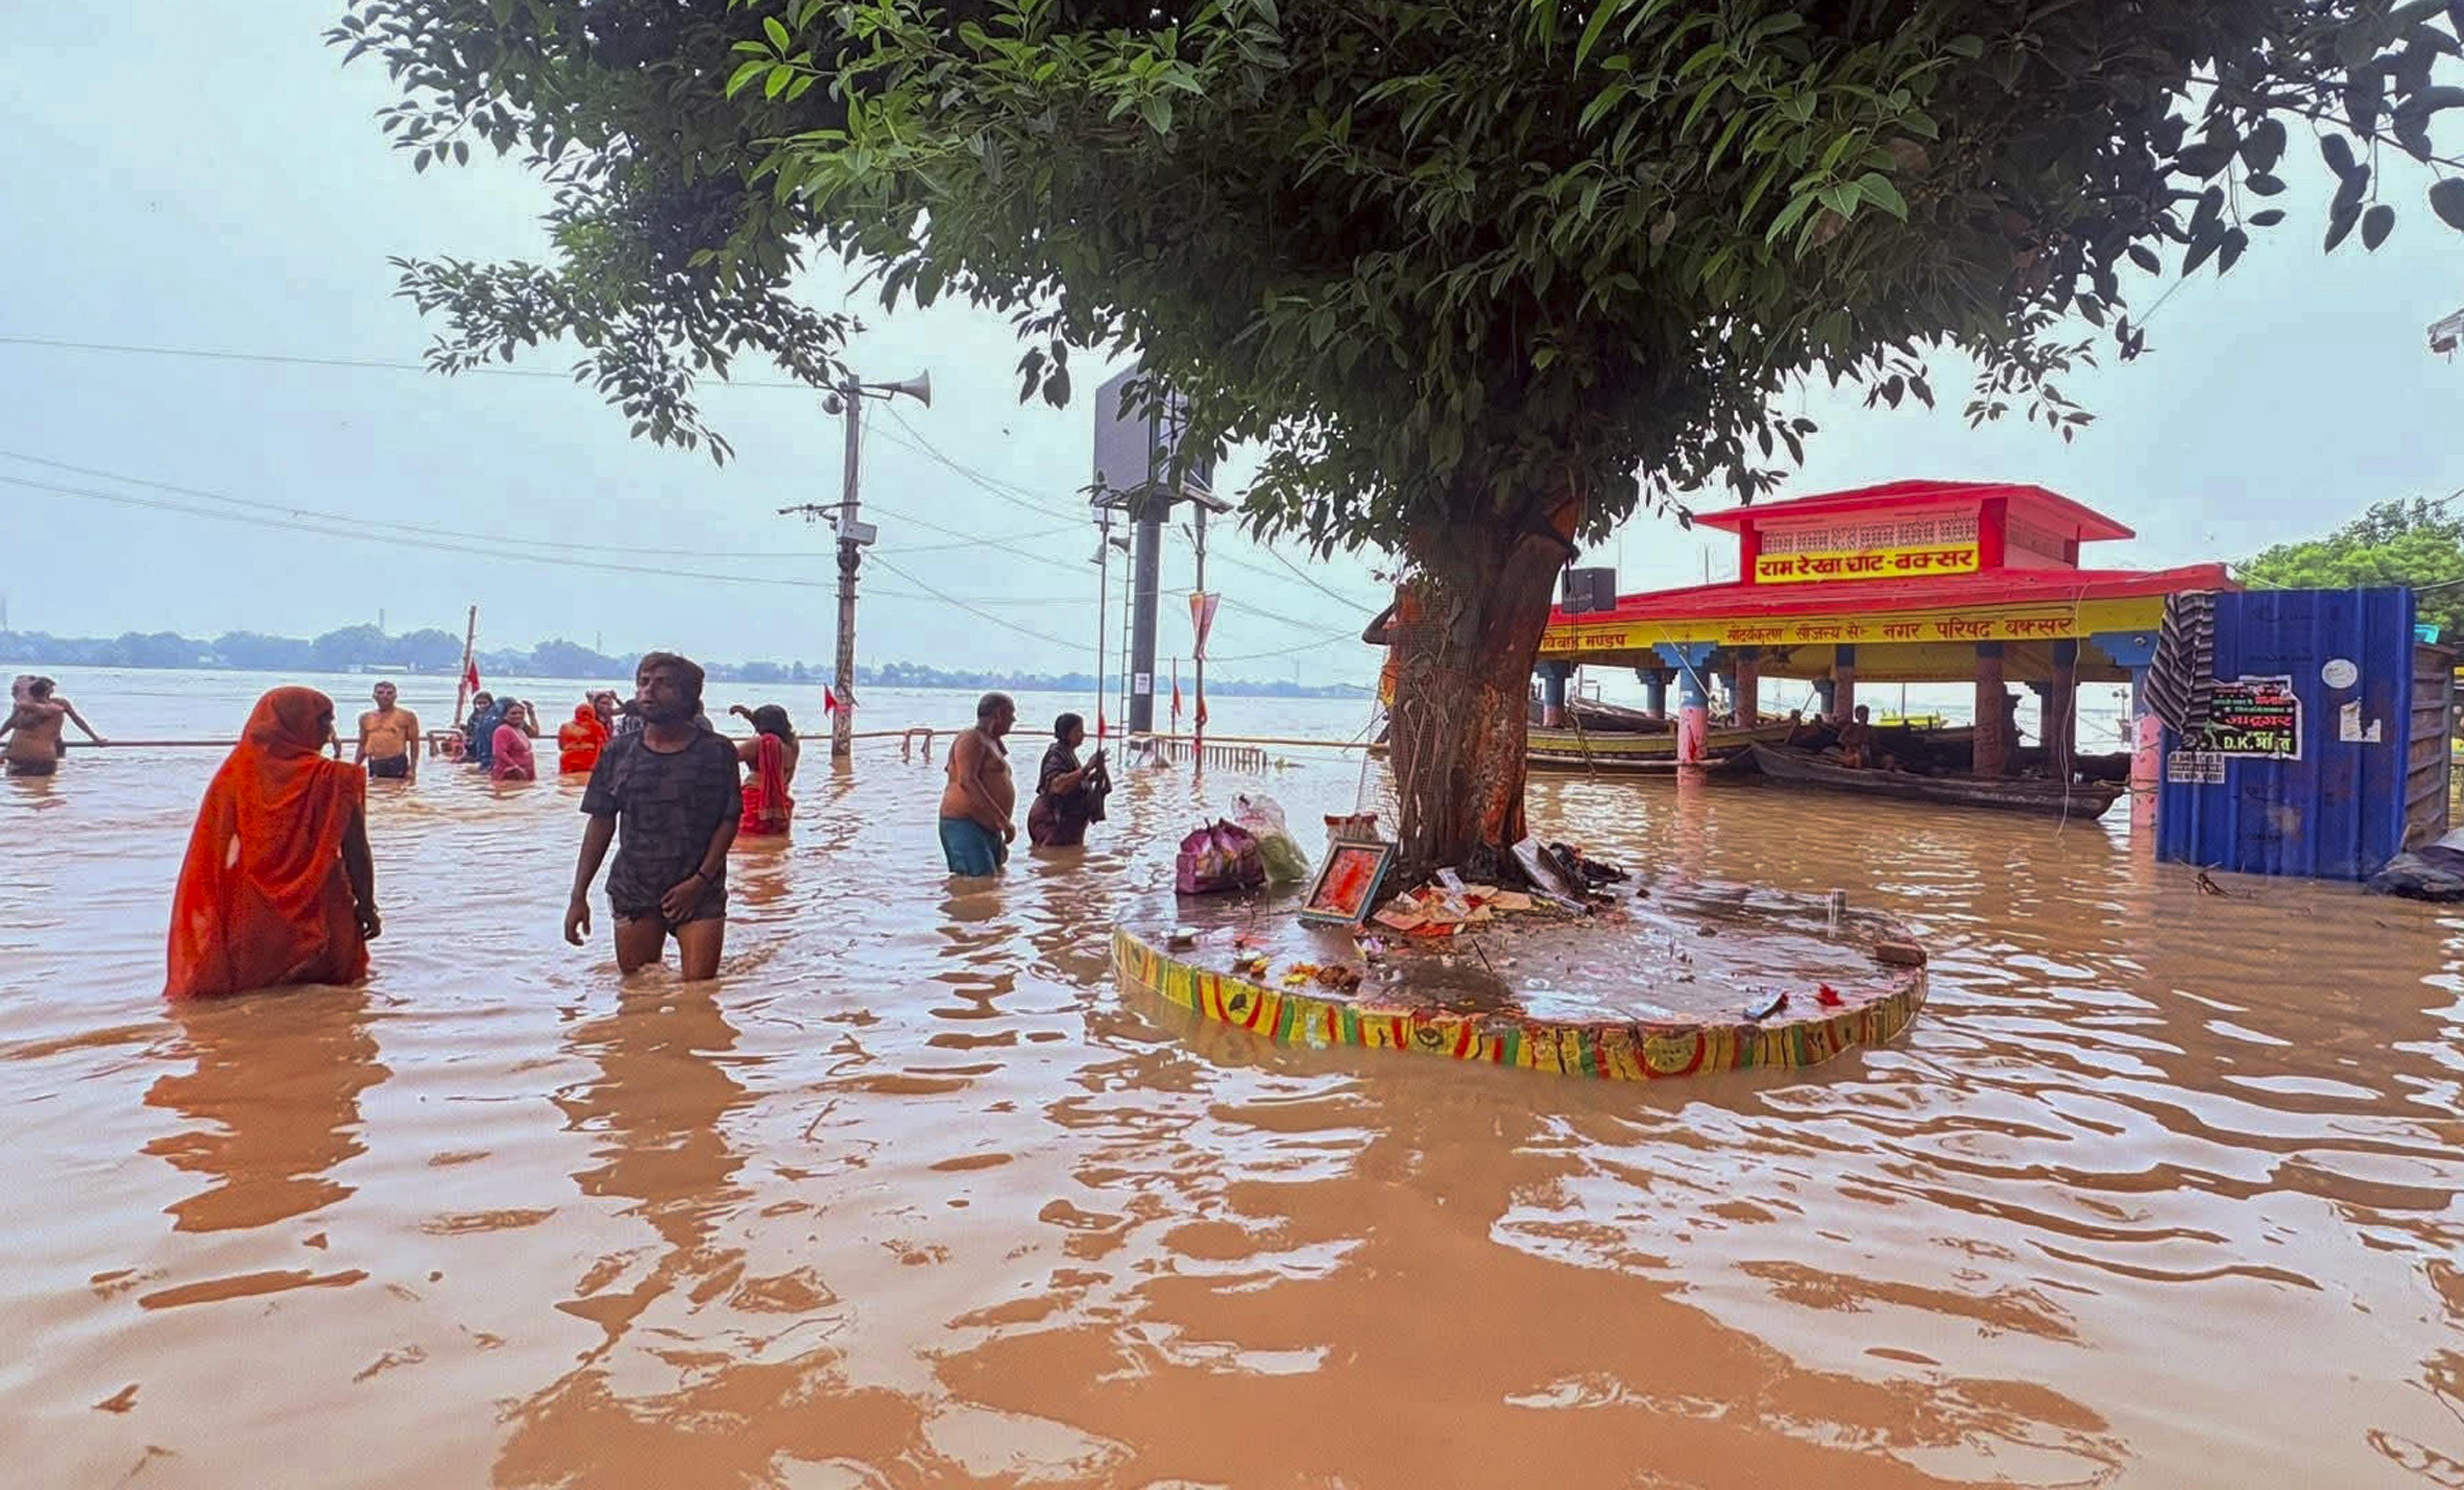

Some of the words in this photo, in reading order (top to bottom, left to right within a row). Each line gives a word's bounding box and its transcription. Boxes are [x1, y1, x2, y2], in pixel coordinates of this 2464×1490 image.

[1759, 560, 1794, 576] राम
[1796, 555, 1843, 574] रेखा
[1845, 555, 1885, 571] घाट
[1882, 622, 1921, 639] नगर
[1586, 634, 1628, 647] मण्डप
